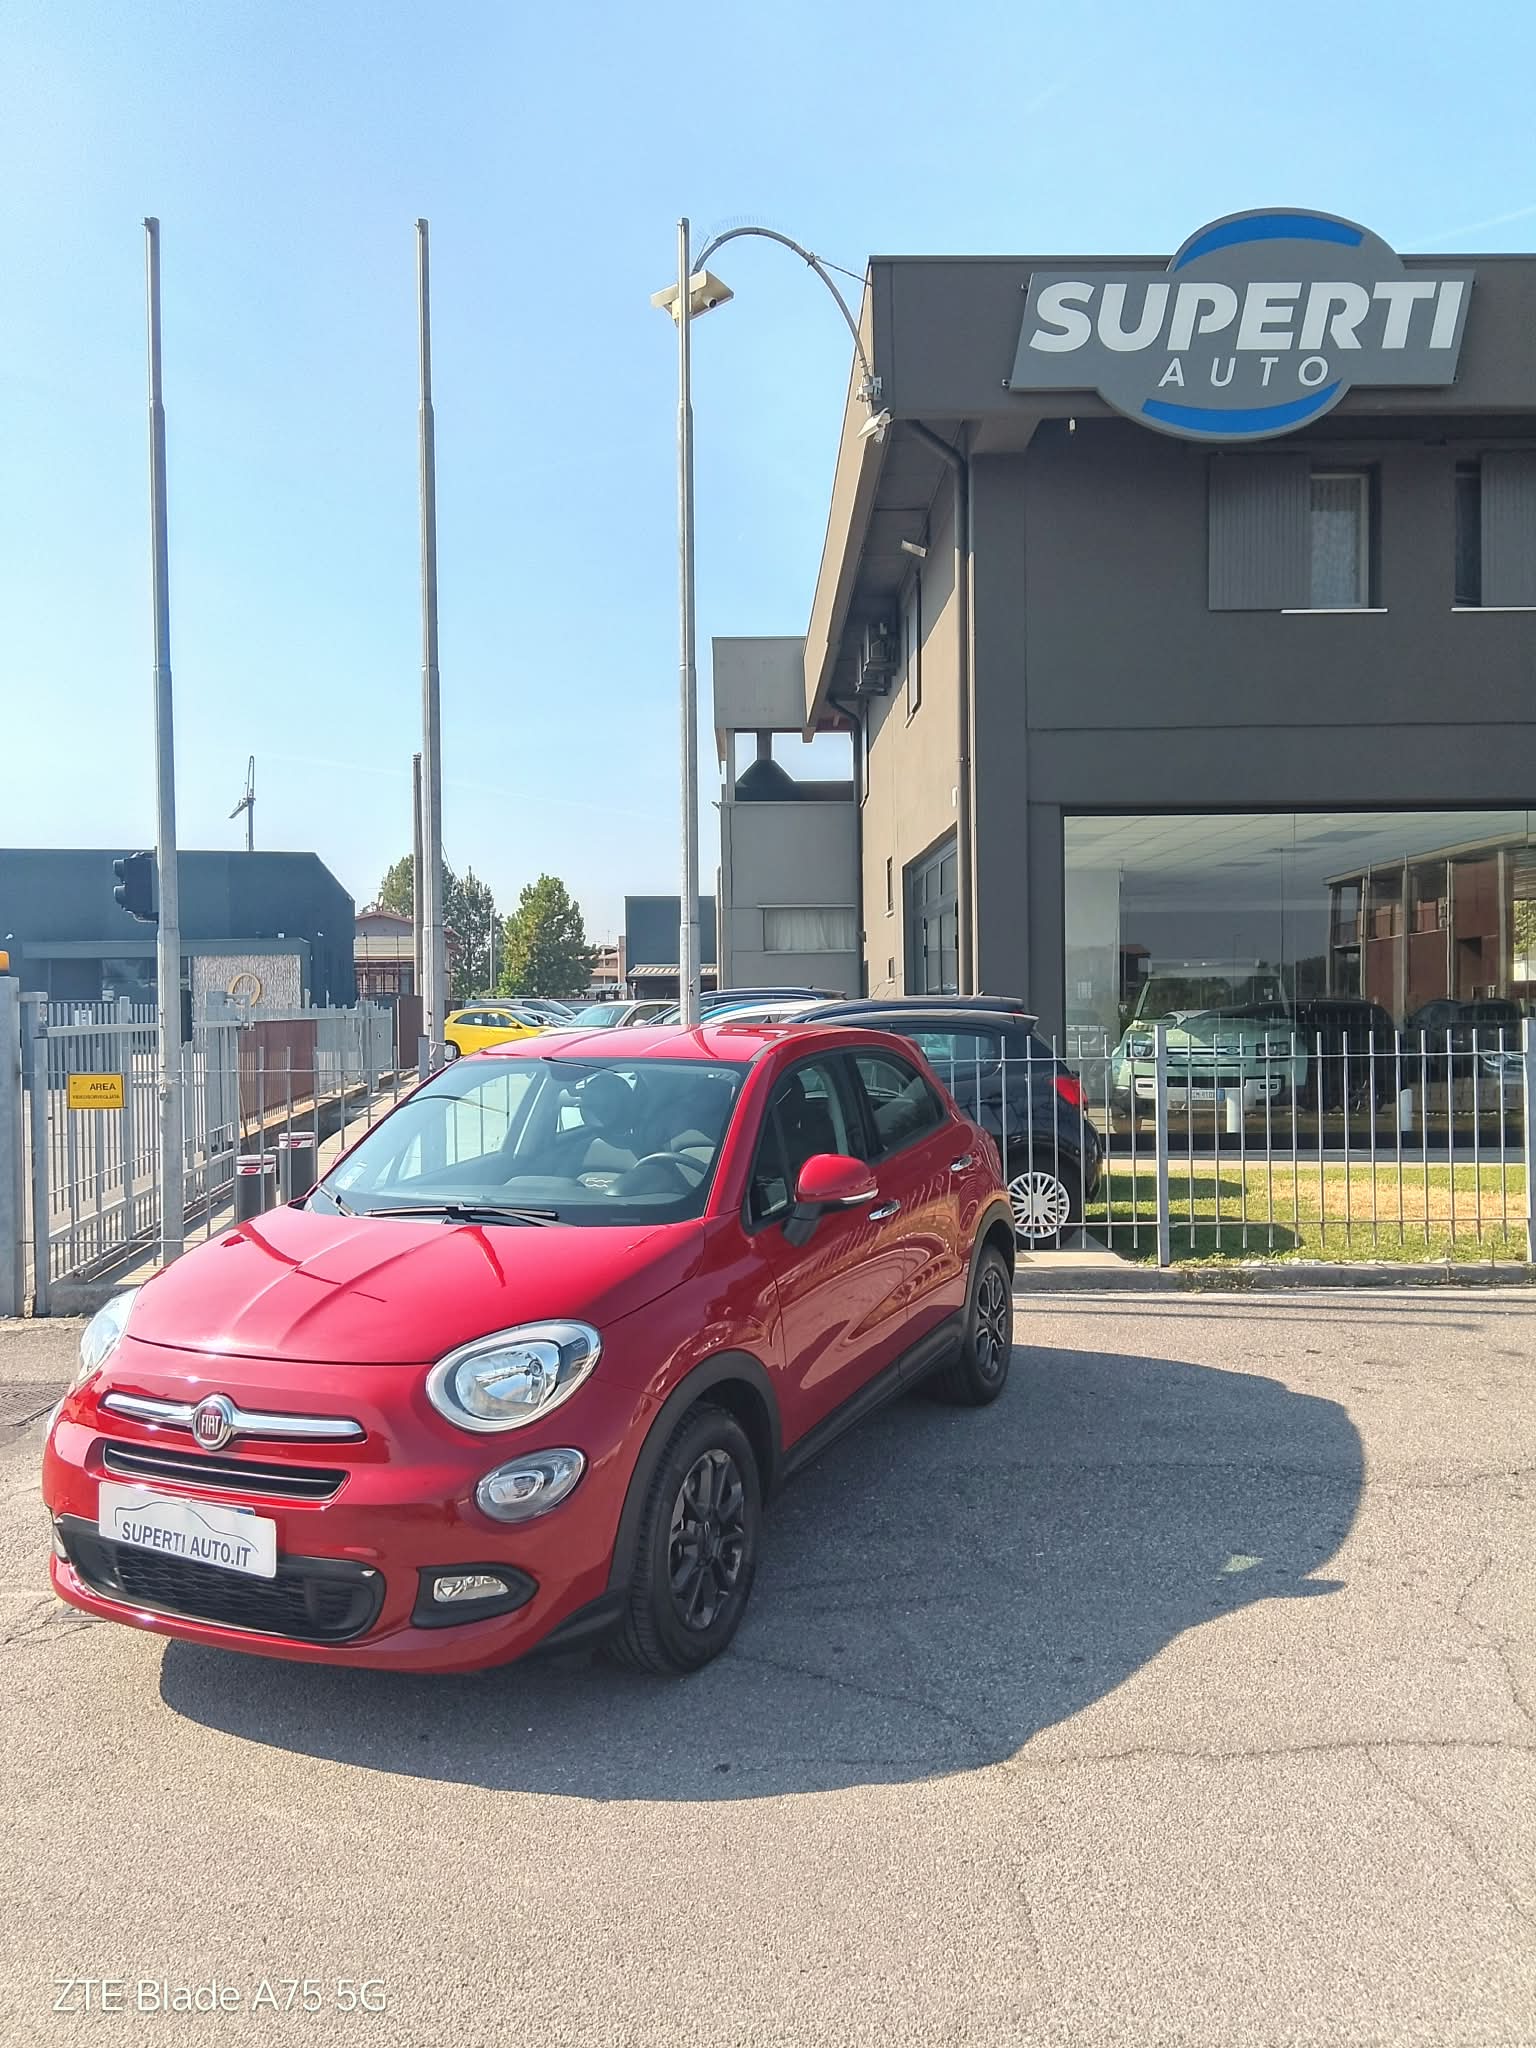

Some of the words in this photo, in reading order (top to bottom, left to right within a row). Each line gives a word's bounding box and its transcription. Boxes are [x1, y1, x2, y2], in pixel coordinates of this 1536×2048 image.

[1029, 281, 1464, 352] SUPERTI
[1158, 356, 1328, 387] AUTO
[90, 1083, 116, 1091] AREA
[201, 1414, 221, 1435] FIAT
[121, 1521, 186, 1553] SUPERTI
[190, 1536, 251, 1567] AUTO.IT
